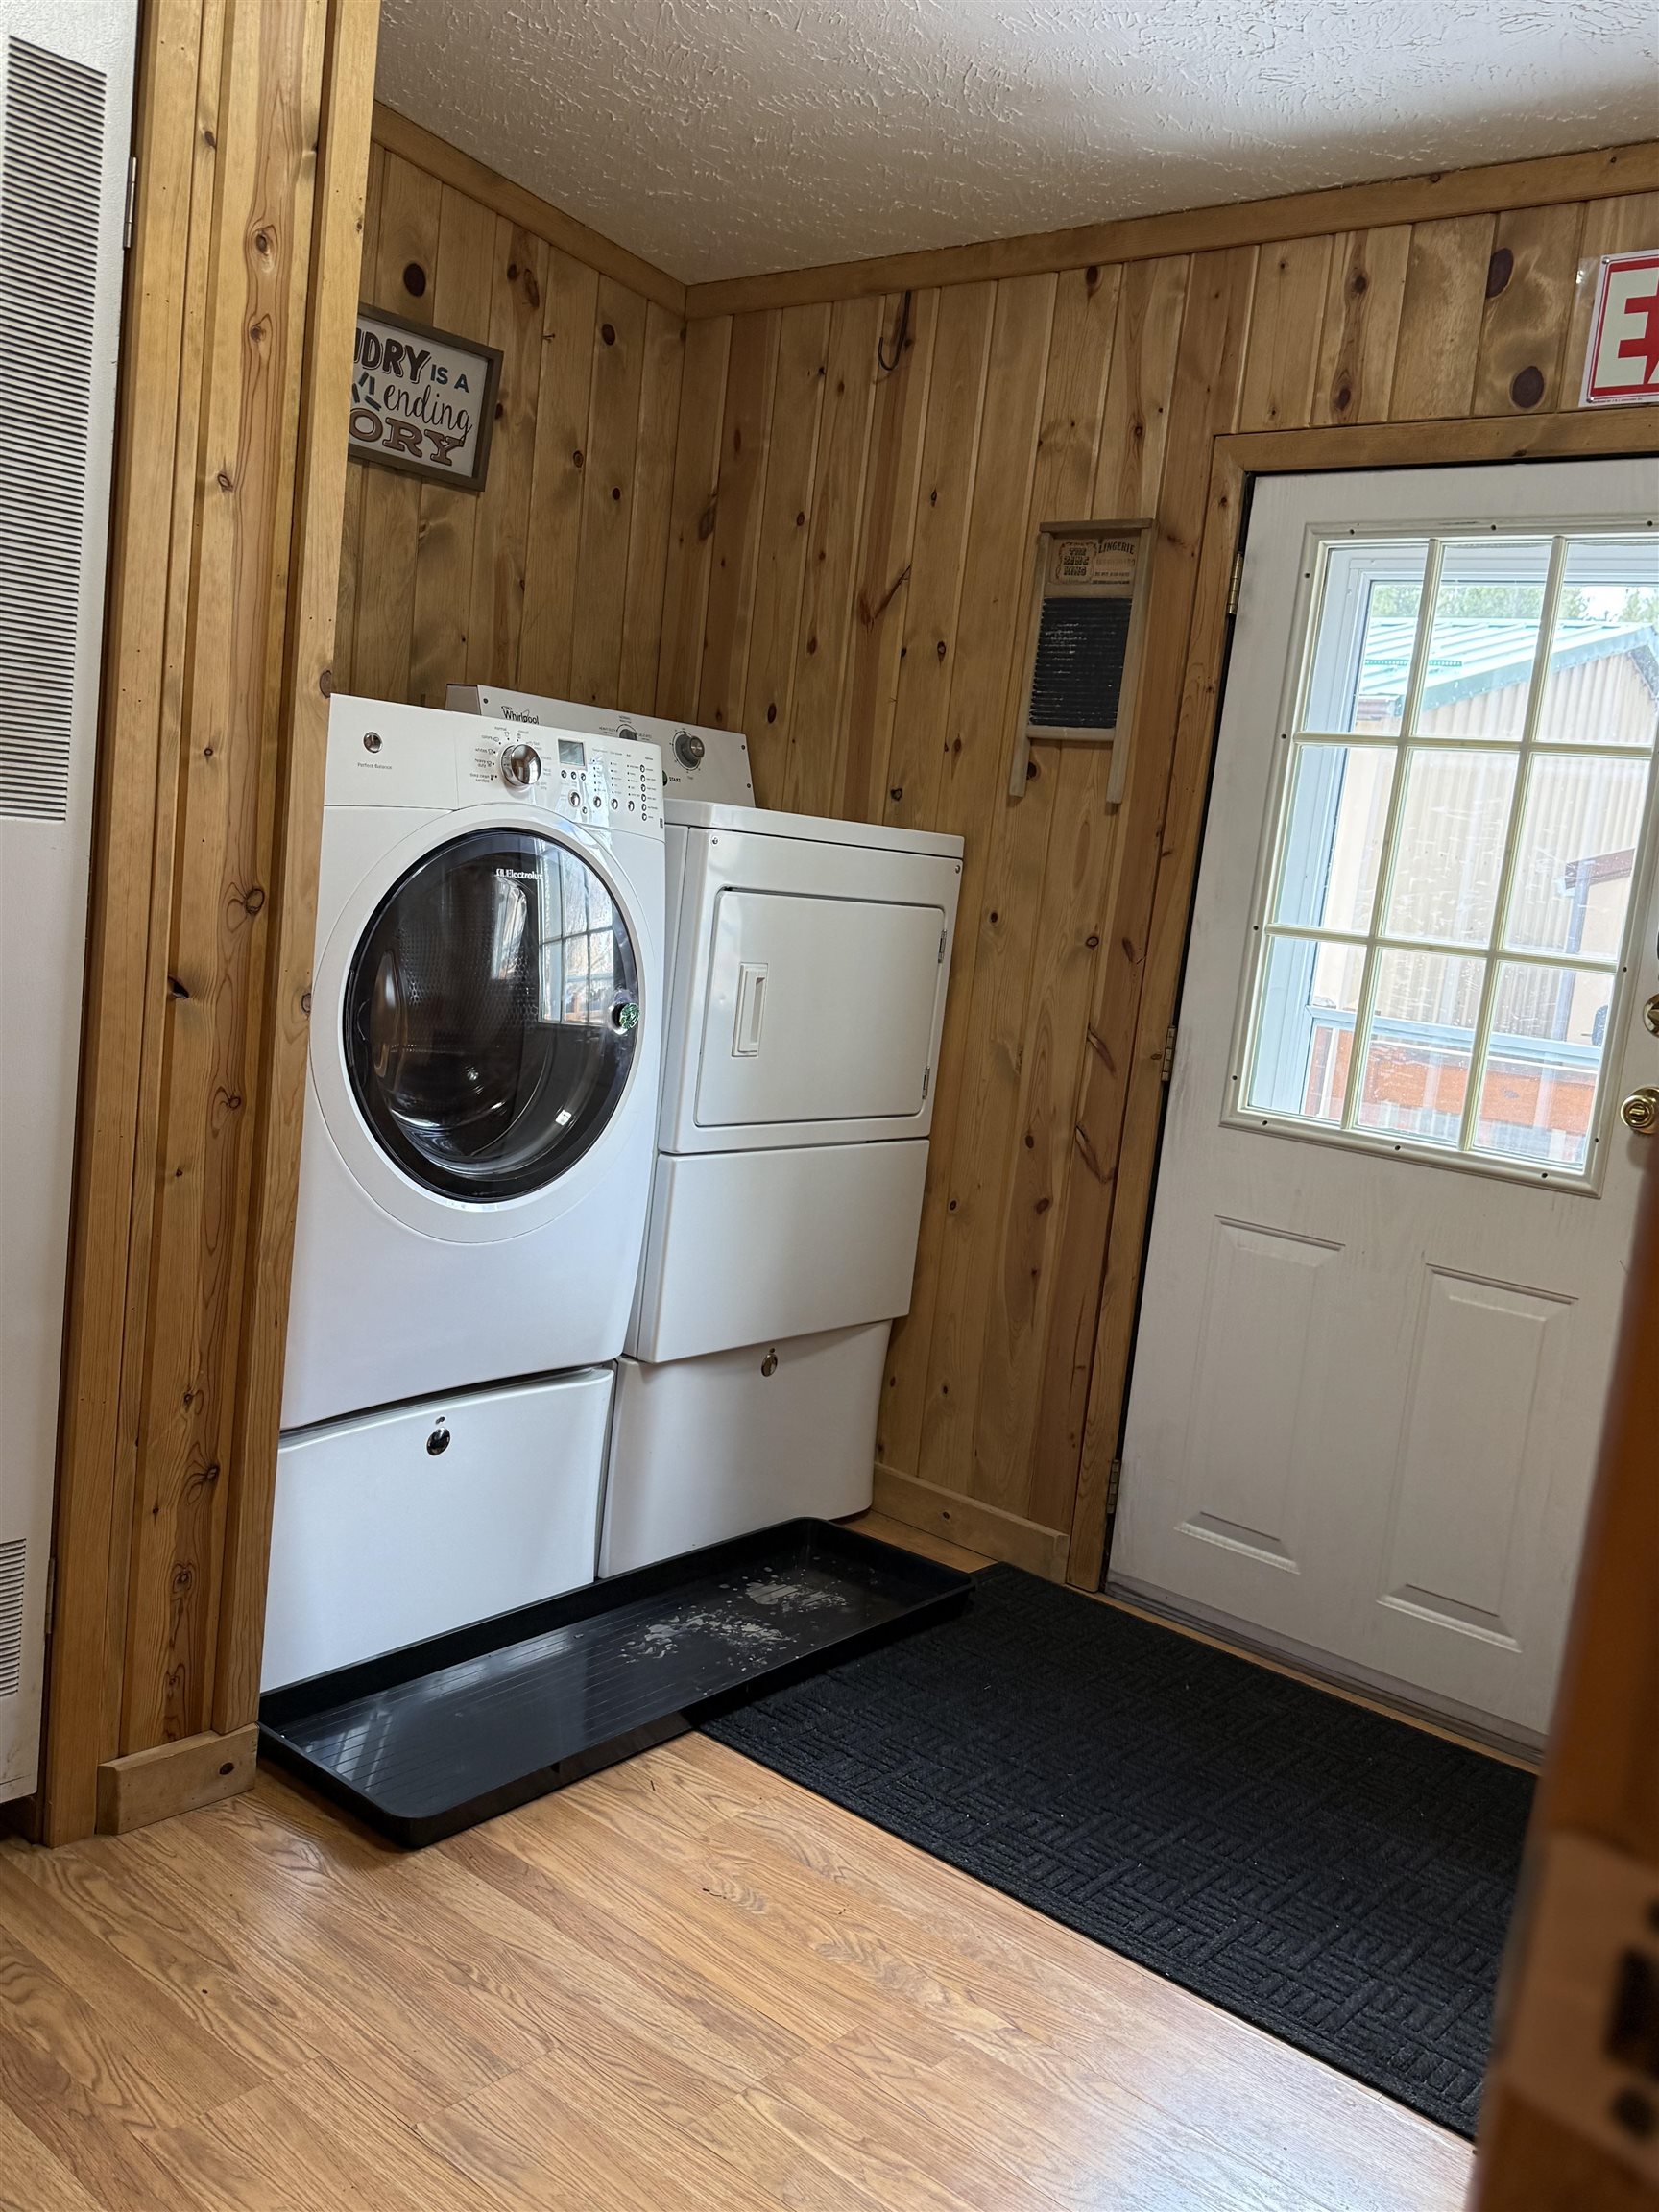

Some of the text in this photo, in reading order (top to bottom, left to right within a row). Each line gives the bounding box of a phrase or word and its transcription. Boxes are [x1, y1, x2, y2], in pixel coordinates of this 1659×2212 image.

[1594, 267, 1659, 389] E
[430, 364, 449, 385] IS
[453, 373, 469, 394] A
[383, 384, 473, 448] ending
[1098, 541, 1135, 554] LINGERIE
[502, 709, 540, 725] Whirlpool
[505, 869, 543, 879] Electrolux
